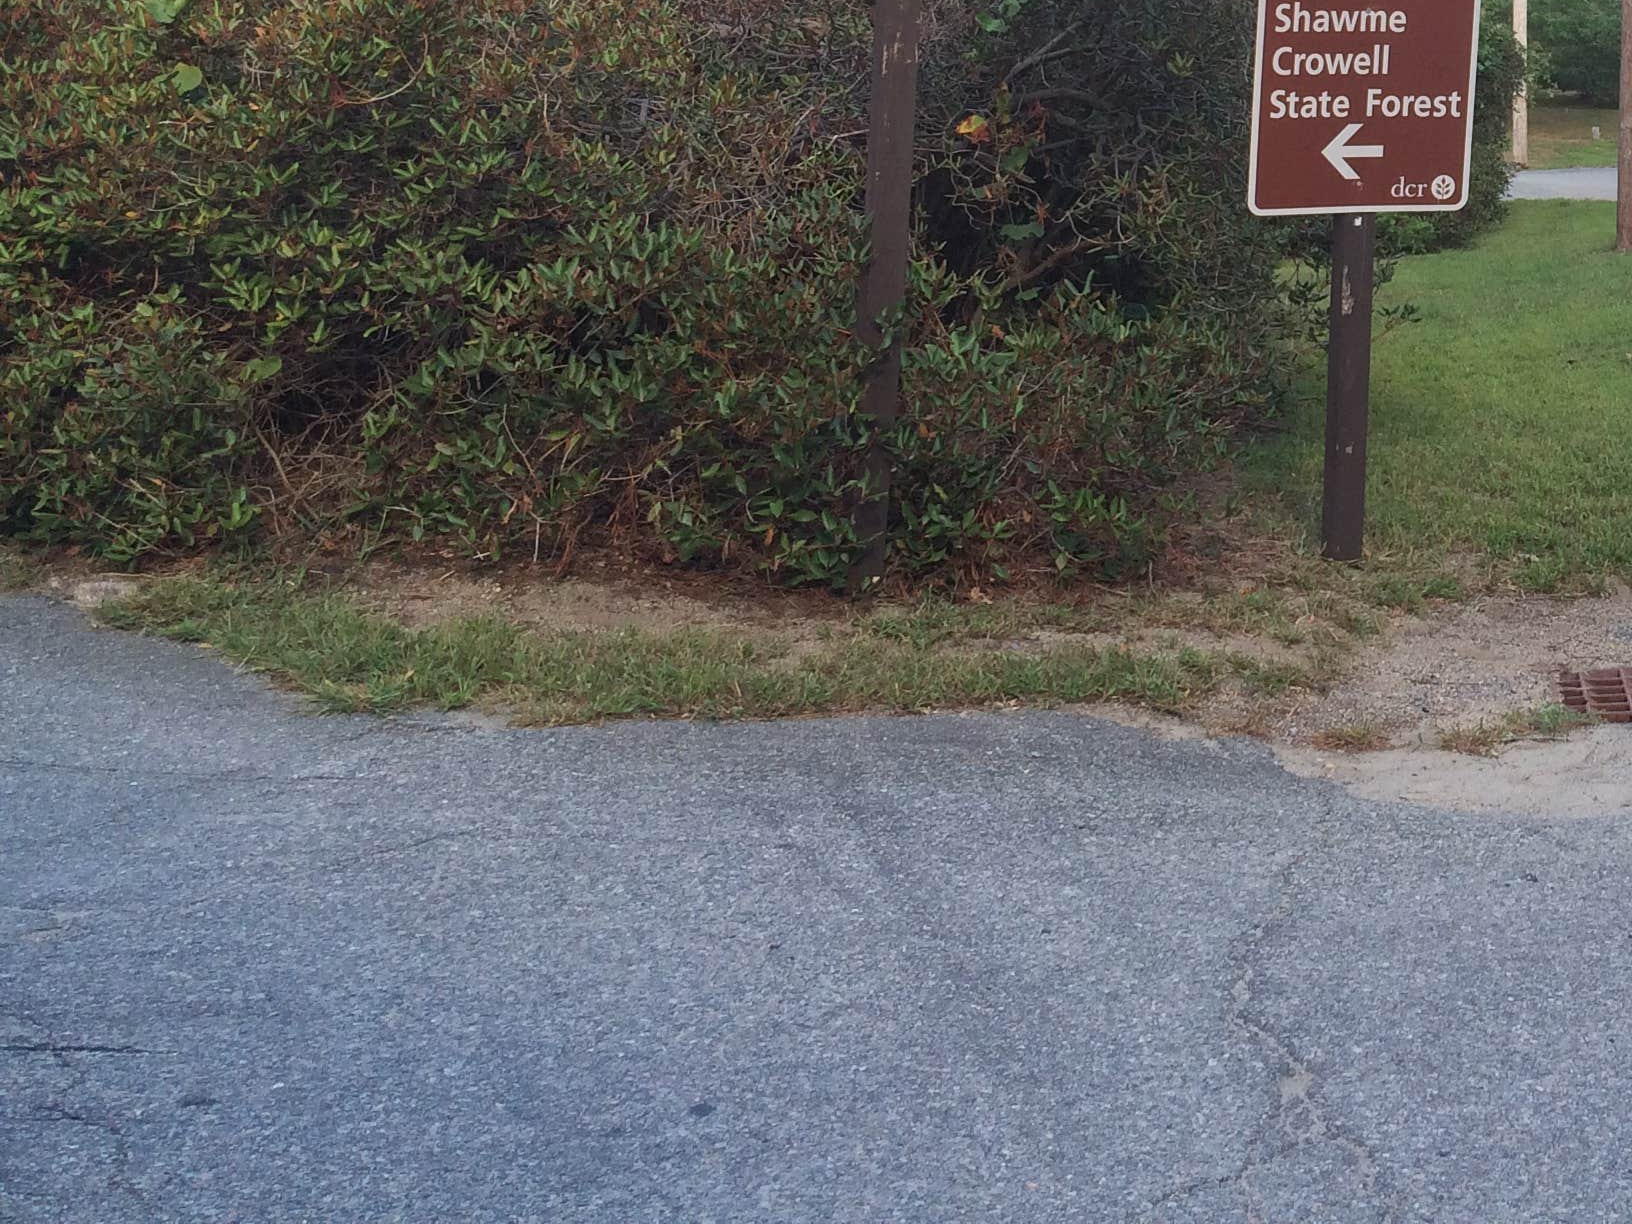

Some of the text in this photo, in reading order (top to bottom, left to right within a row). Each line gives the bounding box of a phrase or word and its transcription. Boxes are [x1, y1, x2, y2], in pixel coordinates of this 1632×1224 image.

[1275, 1, 1407, 33] Shawme
[1272, 44, 1390, 76] Crowell
[1270, 88, 1462, 119] State Forest
[1390, 176, 1428, 198] dcr
